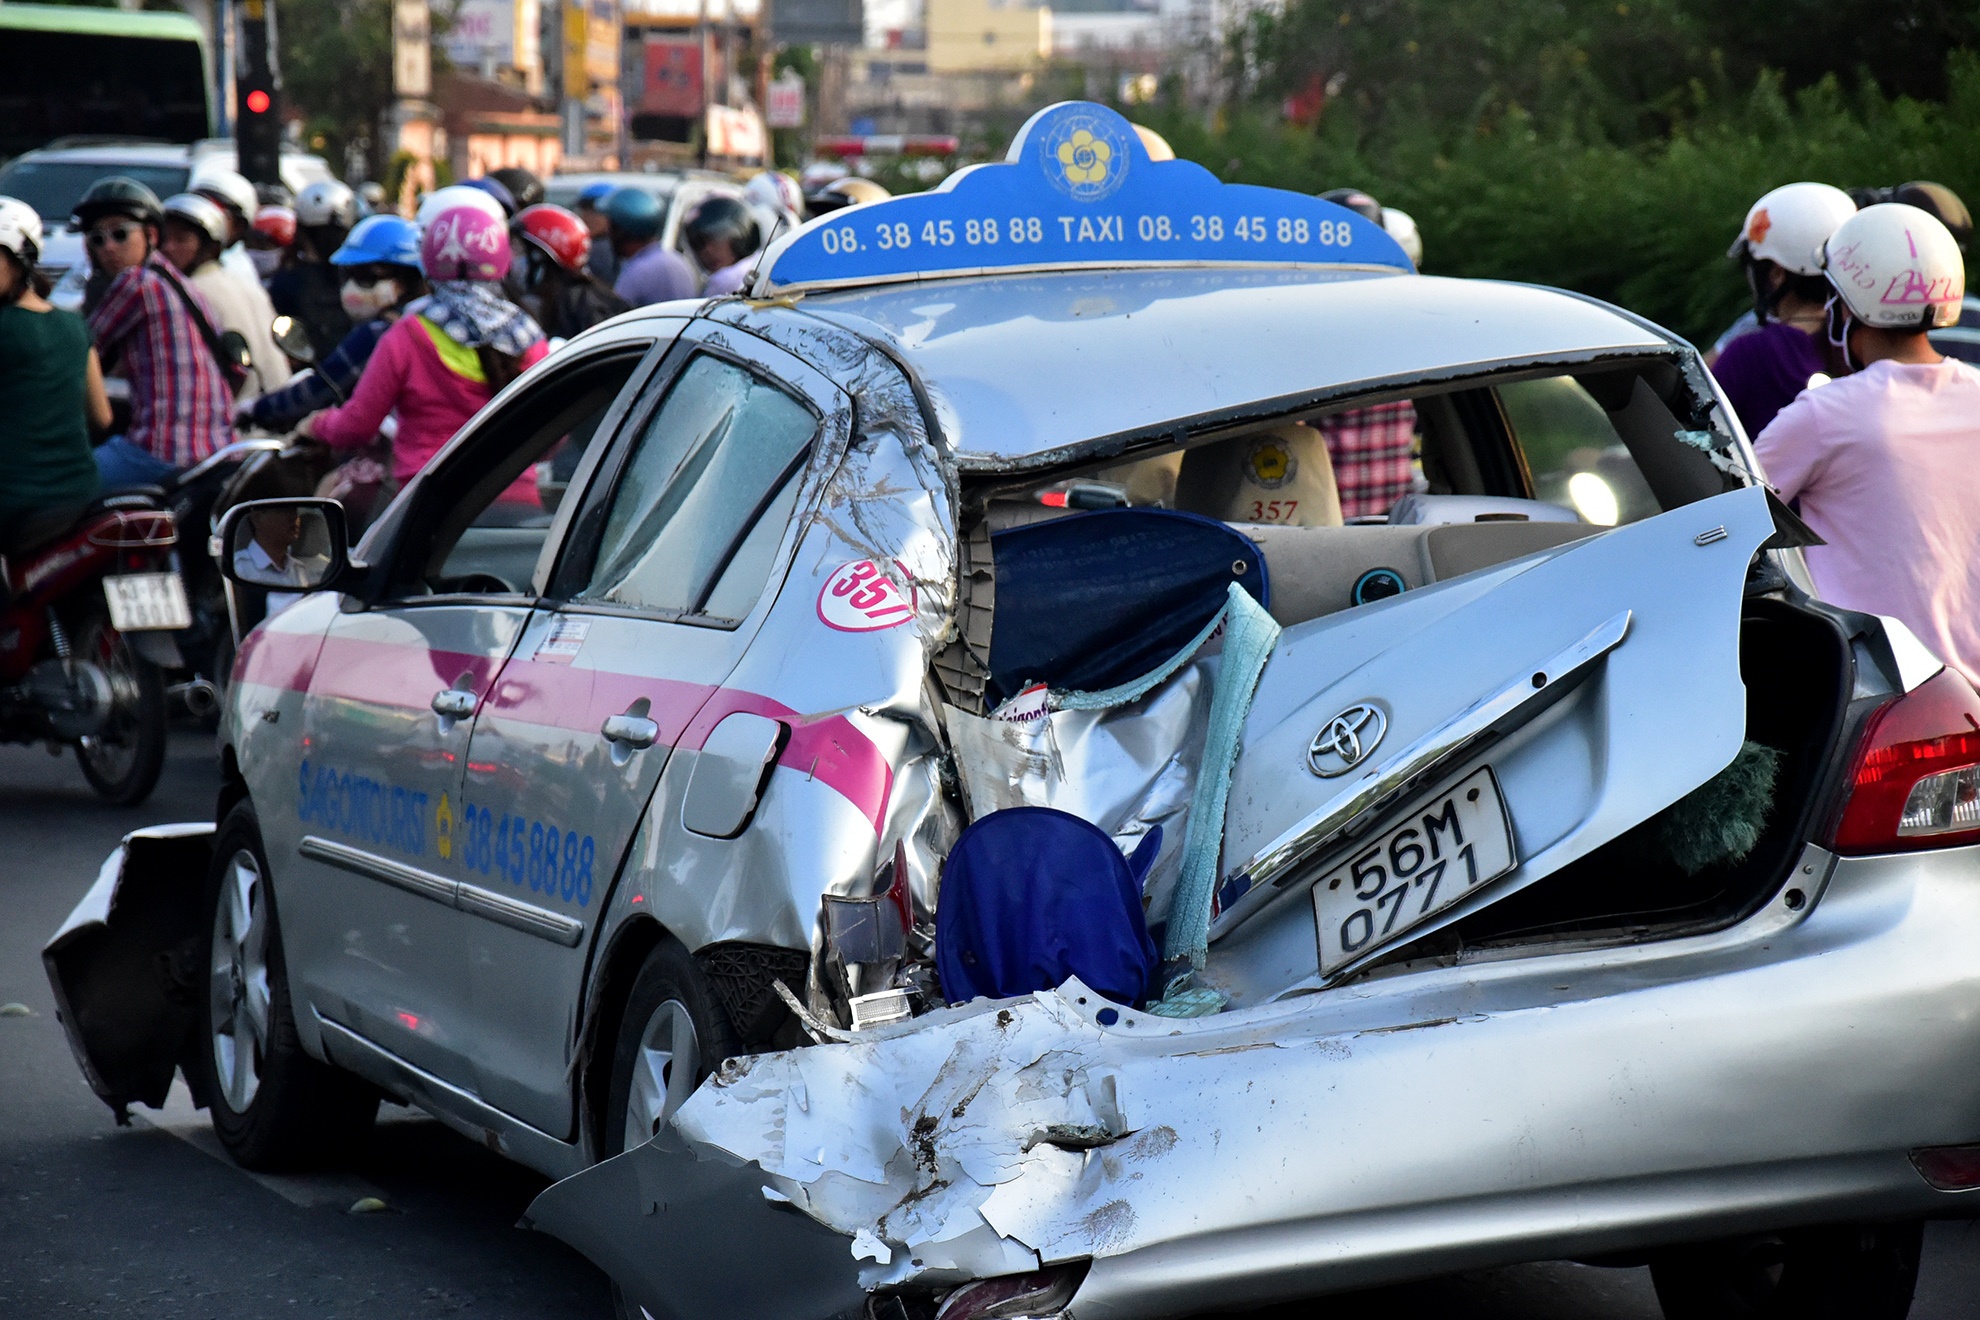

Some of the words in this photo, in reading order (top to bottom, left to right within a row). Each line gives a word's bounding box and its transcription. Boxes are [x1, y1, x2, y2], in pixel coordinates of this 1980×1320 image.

[822, 227, 866, 254] 08.
[875, 223, 912, 249] 38
[921, 220, 955, 246] 45
[965, 218, 999, 244] 88
[1009, 217, 1043, 243] 88
[1058, 216, 1123, 243] TAXI
[1138, 215, 1181, 241] 08.
[1191, 215, 1224, 241] 38
[1234, 216, 1267, 242] 45
[1276, 218, 1310, 244] 88
[1319, 220, 1352, 247] 88
[1248, 500, 1298, 521] 357
[832, 561, 910, 619] 357
[1351, 799, 1464, 901] 56M
[1340, 843, 1479, 953] 0771
